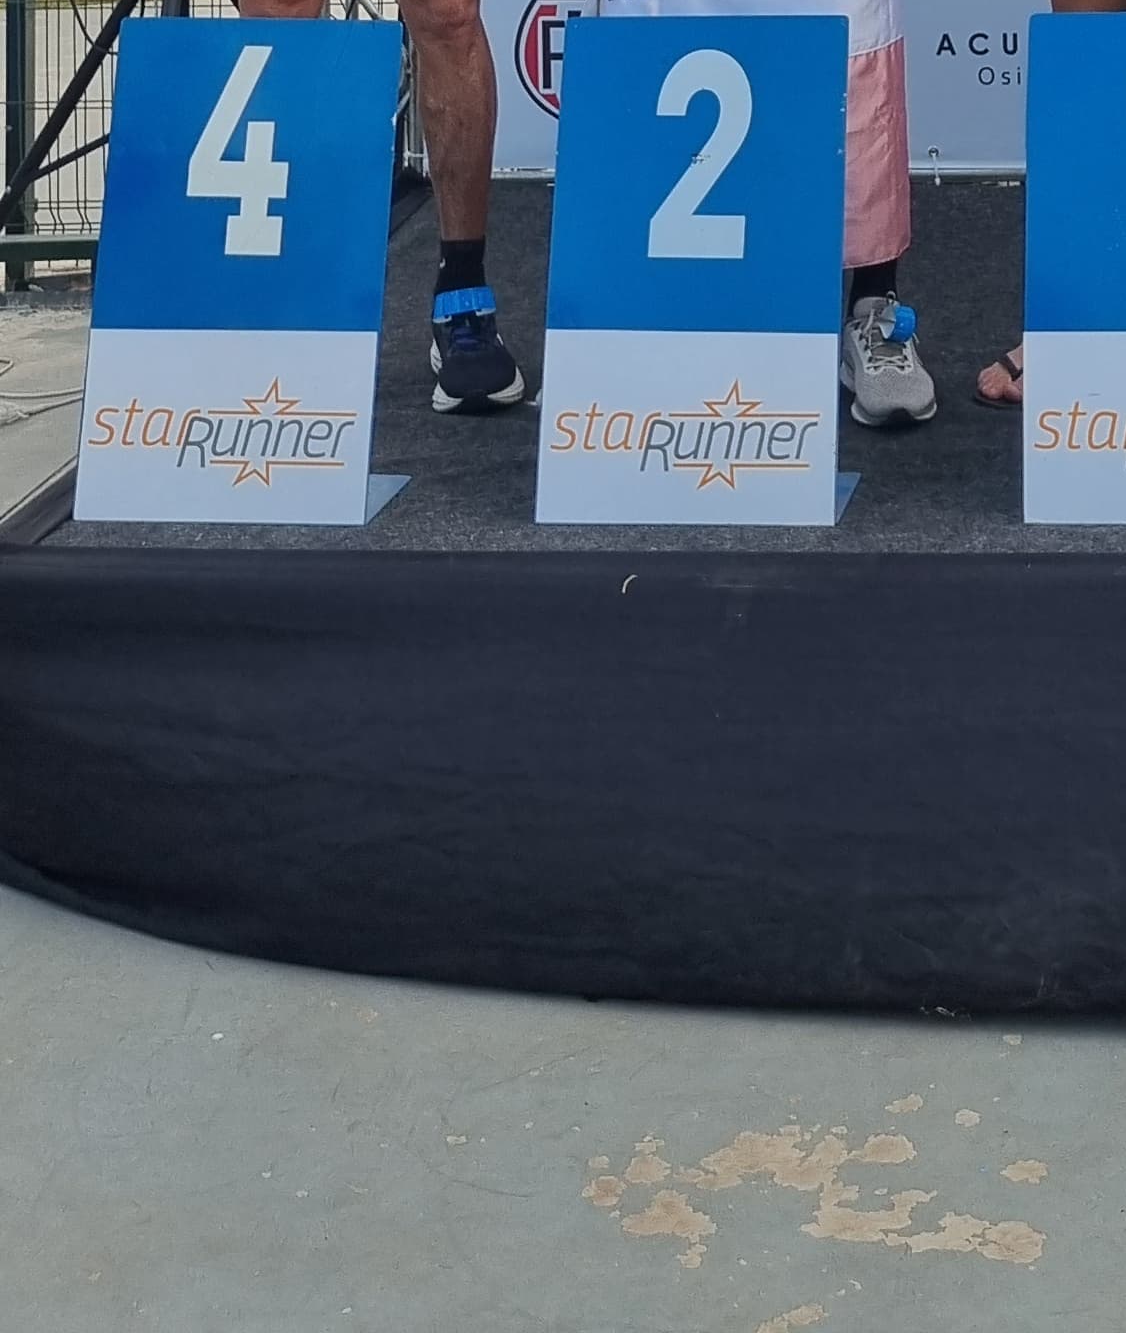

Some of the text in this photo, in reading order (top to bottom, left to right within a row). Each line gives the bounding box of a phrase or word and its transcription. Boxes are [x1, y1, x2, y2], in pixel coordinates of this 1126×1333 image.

[936, 32, 1018, 56] ACU
[978, 66, 1021, 85] Osi
[186, 46, 289, 255] 4
[648, 49, 752, 259] 2
